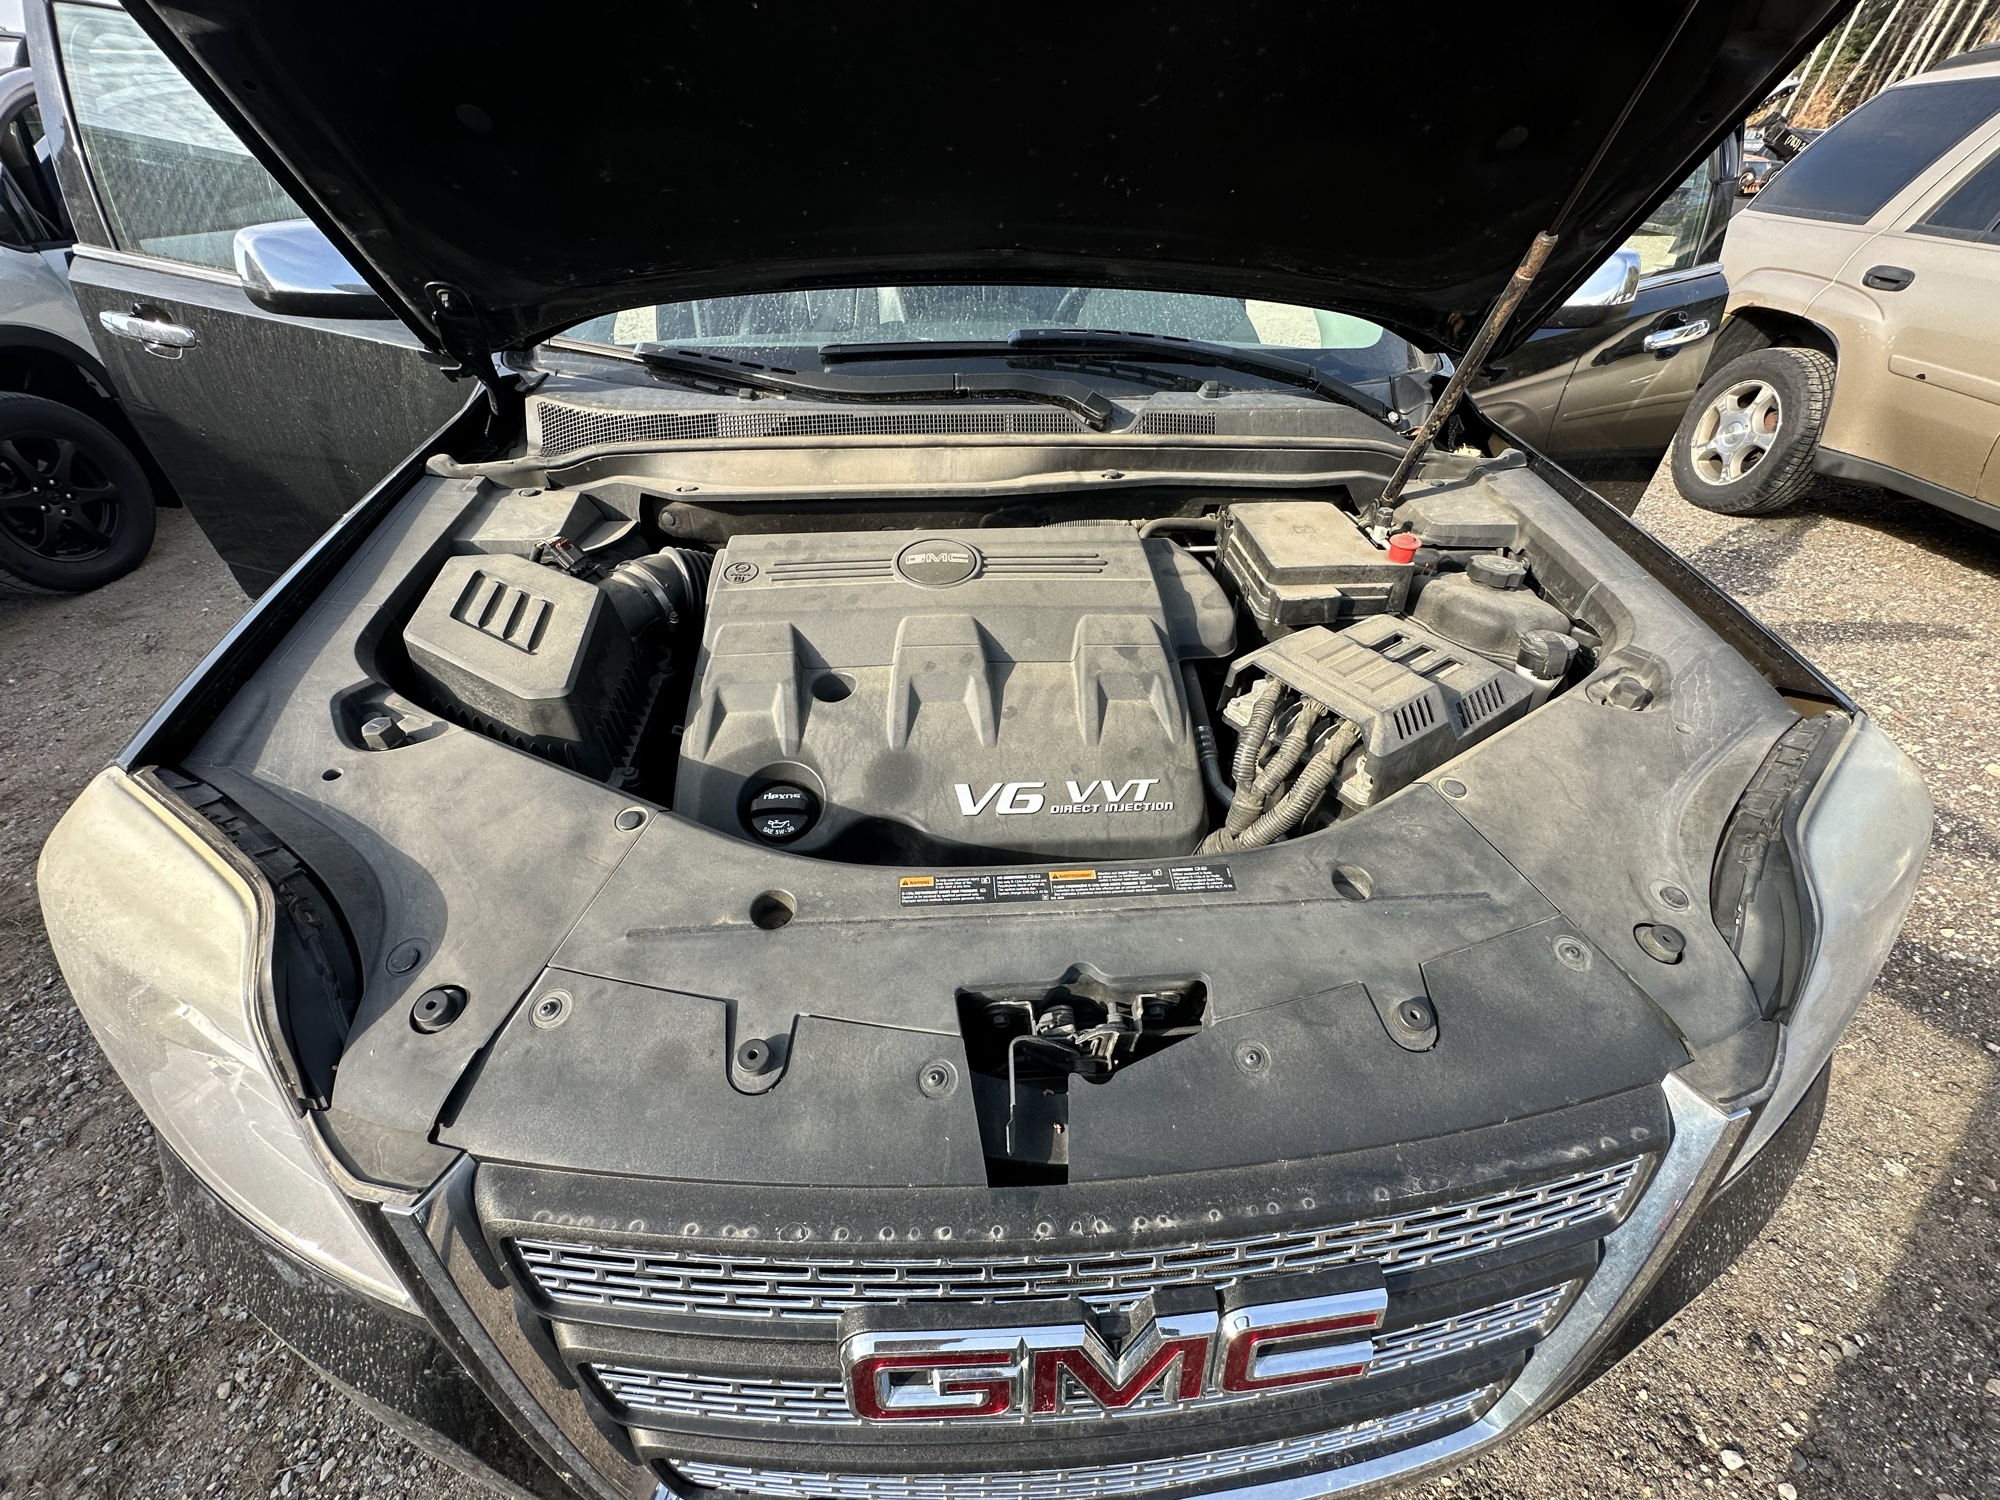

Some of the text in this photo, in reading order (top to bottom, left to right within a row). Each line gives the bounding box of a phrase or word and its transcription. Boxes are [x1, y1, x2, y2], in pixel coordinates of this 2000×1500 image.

[905, 552, 969, 565] GMC
[954, 781, 1046, 816] V6
[1065, 778, 1160, 804] VVT
[1049, 802, 1174, 814] DIRECT INJECTION
[762, 825, 795, 835] SAE 5W-30
[840, 1288, 1388, 1420] GMC
